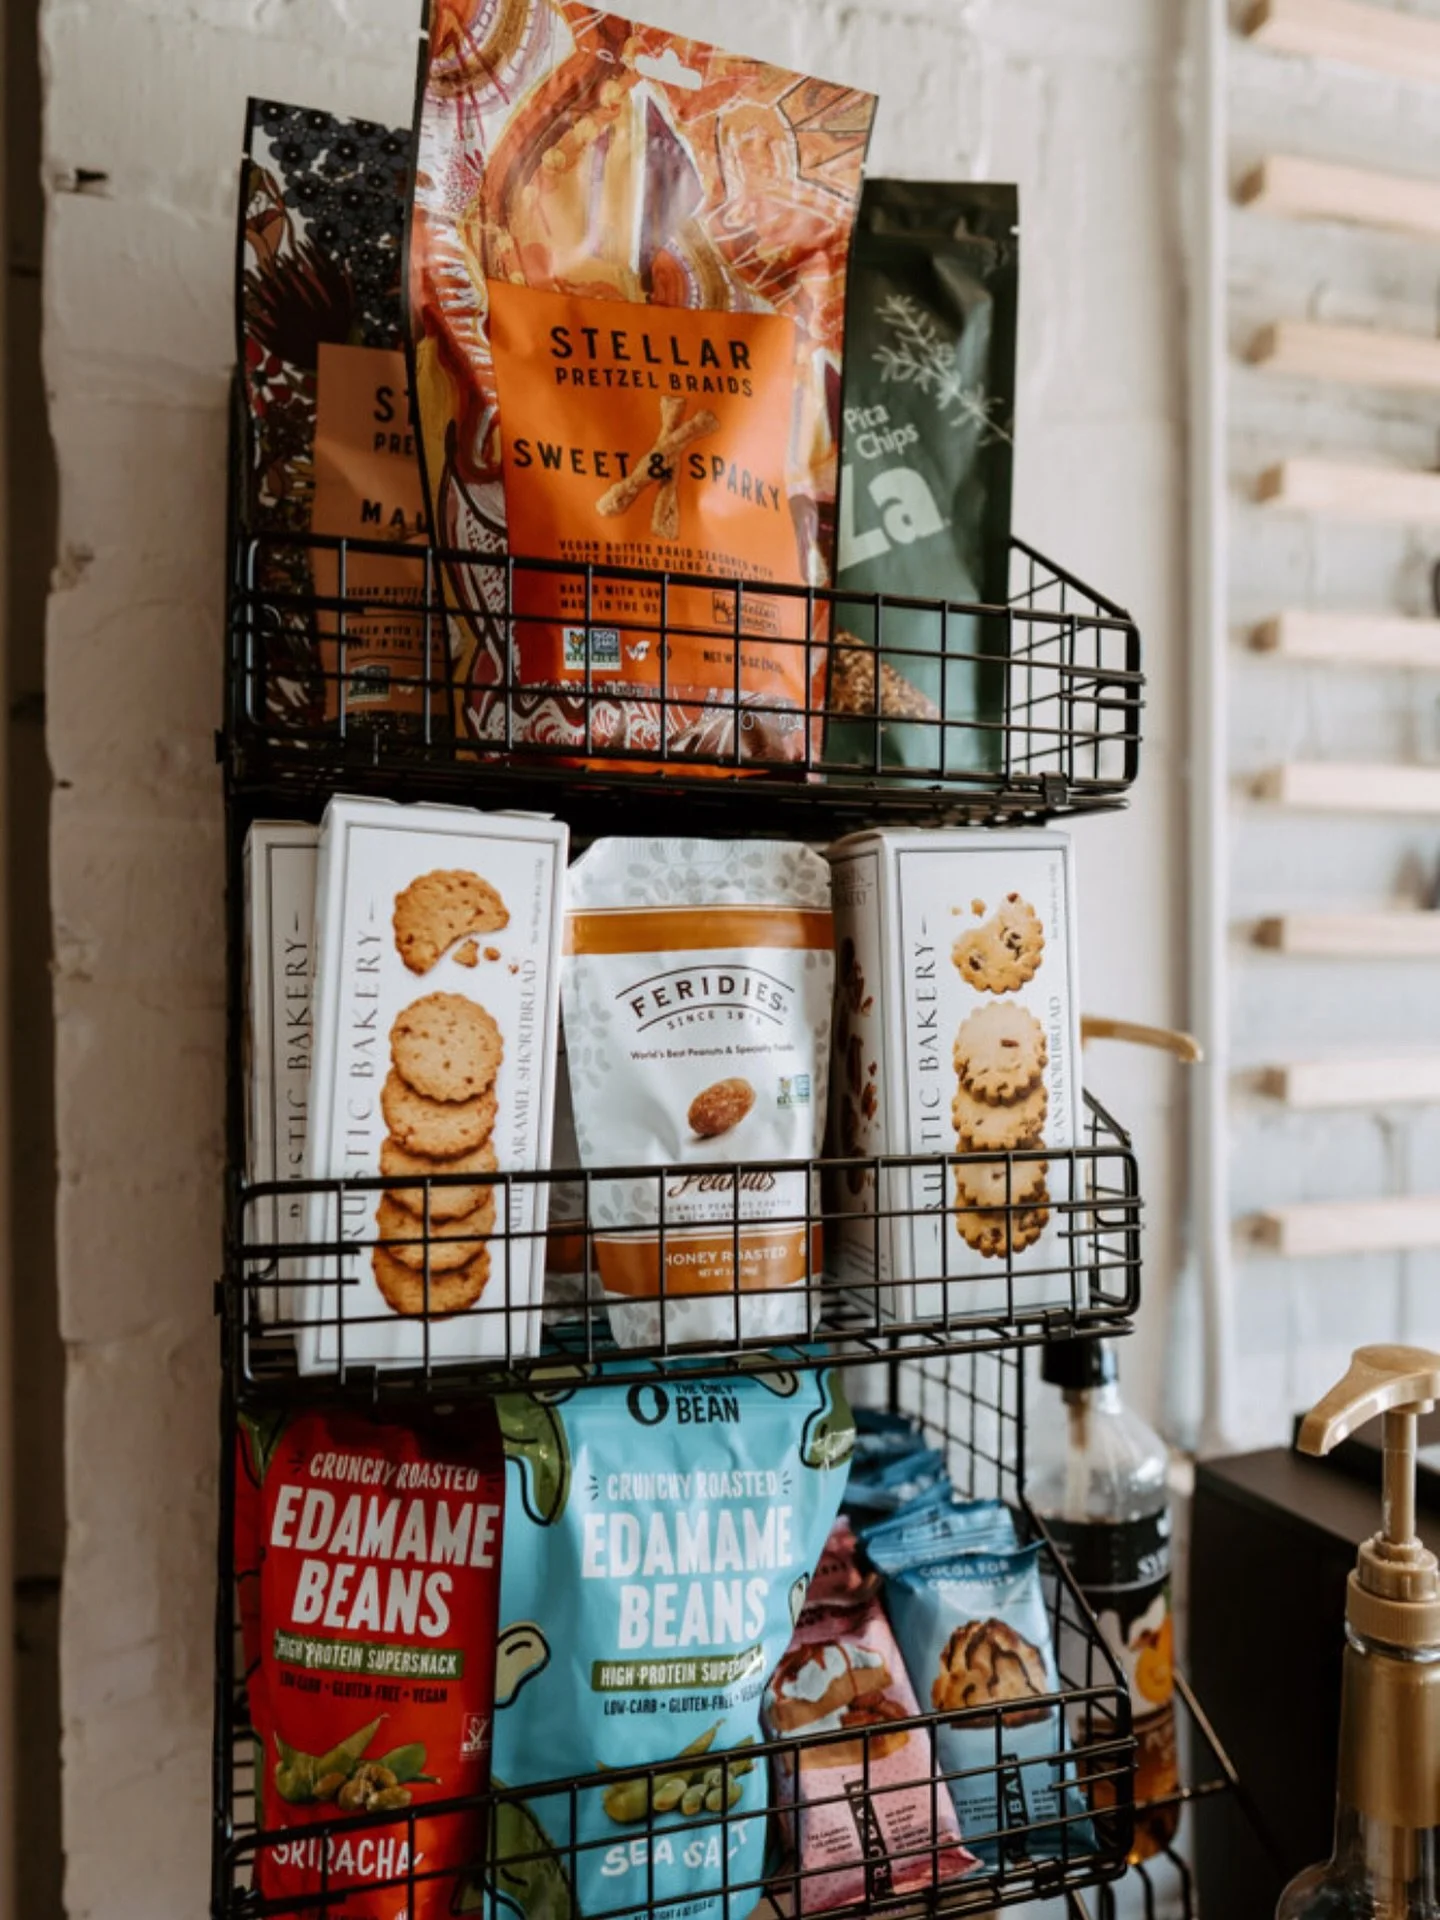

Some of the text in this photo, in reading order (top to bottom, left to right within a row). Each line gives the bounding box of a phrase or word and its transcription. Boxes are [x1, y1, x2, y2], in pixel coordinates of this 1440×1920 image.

[550, 326, 752, 371] STELLAR
[556, 367, 754, 397] PRETZEL BRAIDS
[844, 403, 890, 433] Pita
[856, 422, 919, 460] Chips
[513, 438, 781, 512] SWEET & SPARKY
[559, 540, 599, 552] VEGAN
[606, 541, 651, 554] BUTTER
[560, 584, 599, 597] BAKD
[640, 587, 661, 600] LOV
[629, 976, 784, 1018] FERIDIES
[516, 960, 537, 1082] SHORTBREAD
[666, 1010, 715, 1030] SINCE
[667, 1048, 686, 1058] Best
[688, 1046, 724, 1057] Peanuts
[285, 938, 309, 1219] RSTIC BAKERY
[341, 929, 383, 1242] RUSTIC BAKERY
[915, 943, 942, 1213] RUTIC BAKERY
[721, 1245, 788, 1261] RASTED
[675, 1396, 740, 1424] BEAN
[309, 1452, 480, 1492] CRUNCHY ROASTED
[607, 1469, 778, 1501] CRUNCHY ROASTED
[270, 1484, 500, 1569] EDAMAME
[581, 1505, 794, 1579] EDAMAME
[920, 1559, 1011, 1578] COCOA FOR
[927, 1574, 1016, 1591] COCONUTS
[291, 1559, 453, 1638] BEANS
[618, 1577, 769, 1649] BEANS
[304, 1642, 363, 1668] PROTEIN
[367, 1647, 457, 1675] SUPERSNACK
[639, 1662, 698, 1685] PROTEIN
[604, 1698, 658, 1716] LOW-CARB
[271, 1826, 424, 1880] SRIRACHA
[601, 1820, 749, 1877] SEA SAT
